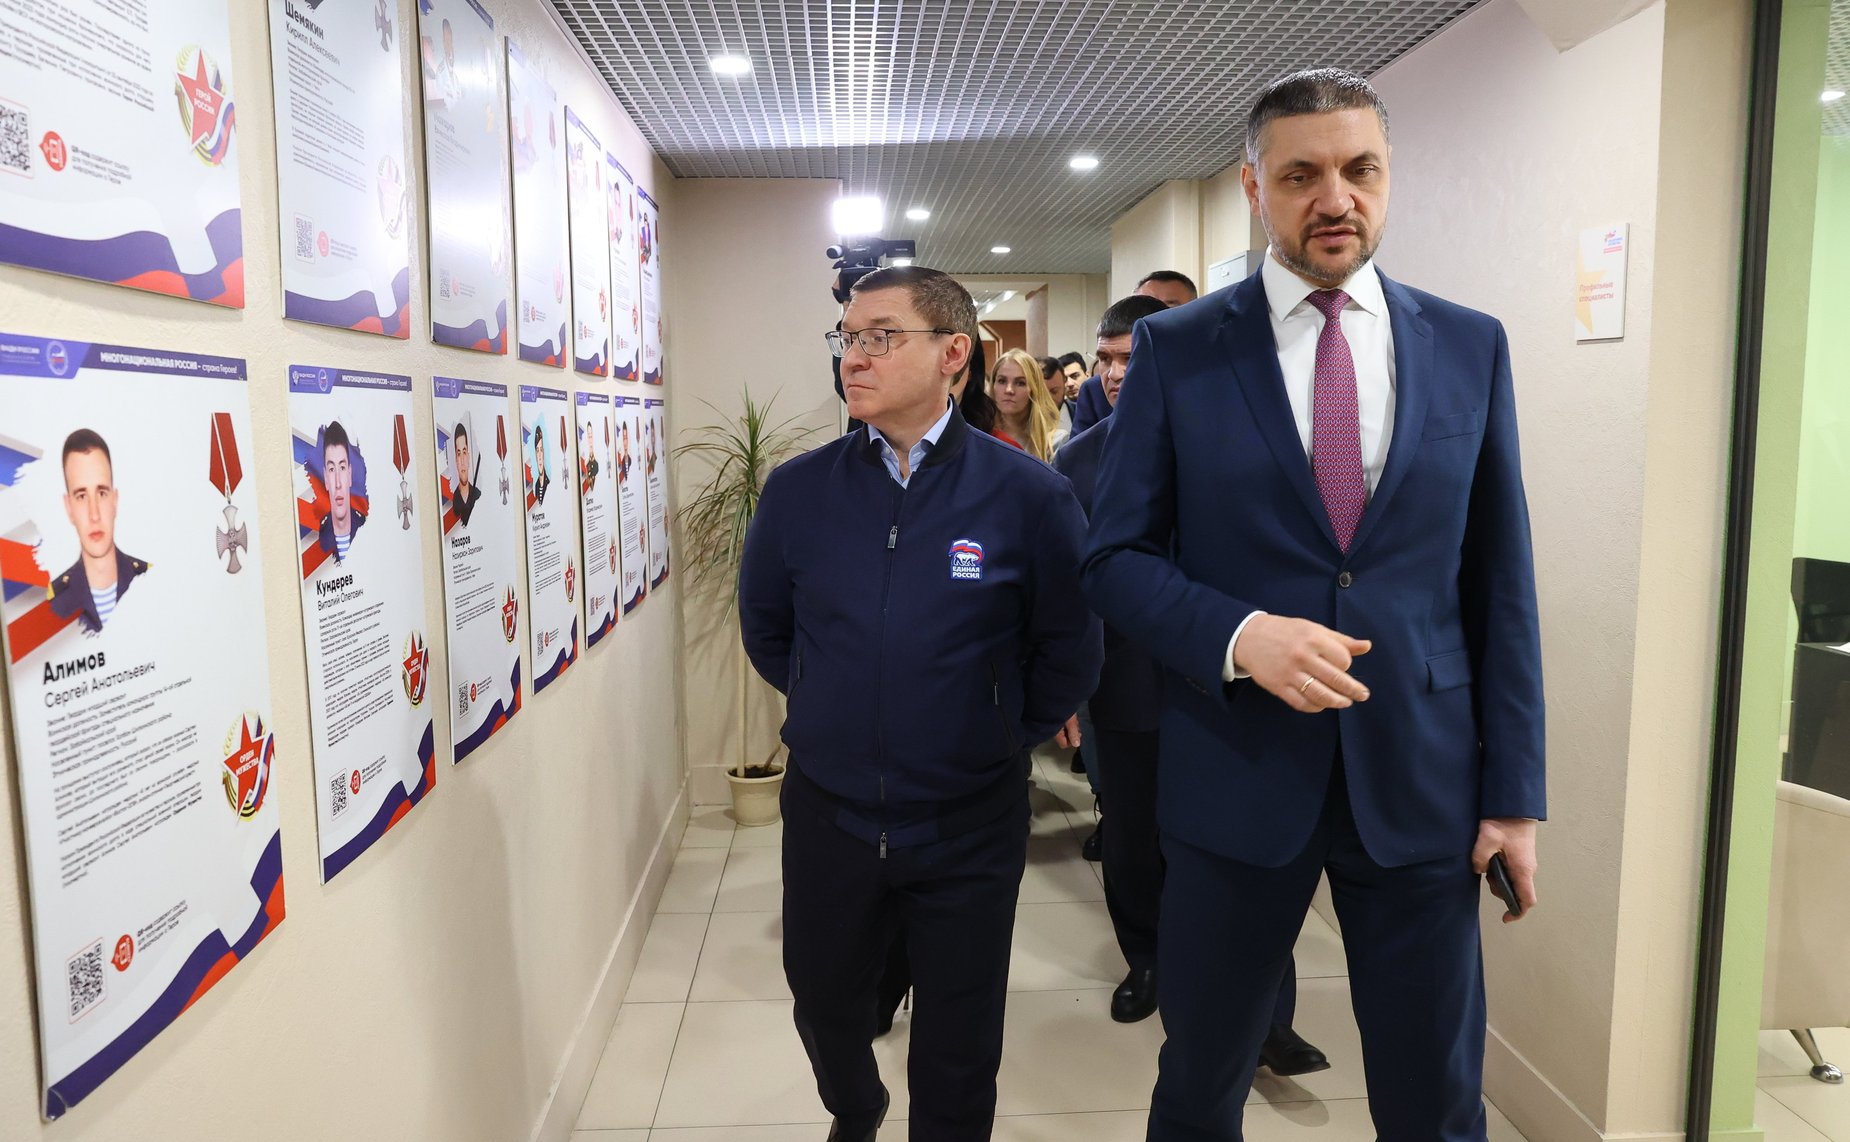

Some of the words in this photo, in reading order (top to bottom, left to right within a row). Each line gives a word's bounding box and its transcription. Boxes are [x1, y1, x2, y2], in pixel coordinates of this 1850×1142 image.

[285, 0, 324, 40] Шемякин
[100, 351, 174, 369] МНОГОНАЦИОНАЛЬНАЯ
[174, 359, 198, 371] РОССИЯ
[316, 574, 354, 597] Кундерев
[318, 594, 341, 611] Виталий
[340, 588, 364, 603] Олегович
[43, 651, 106, 685] Алимов
[44, 681, 88, 708] Сергей
[91, 661, 156, 693] Анатольевич
